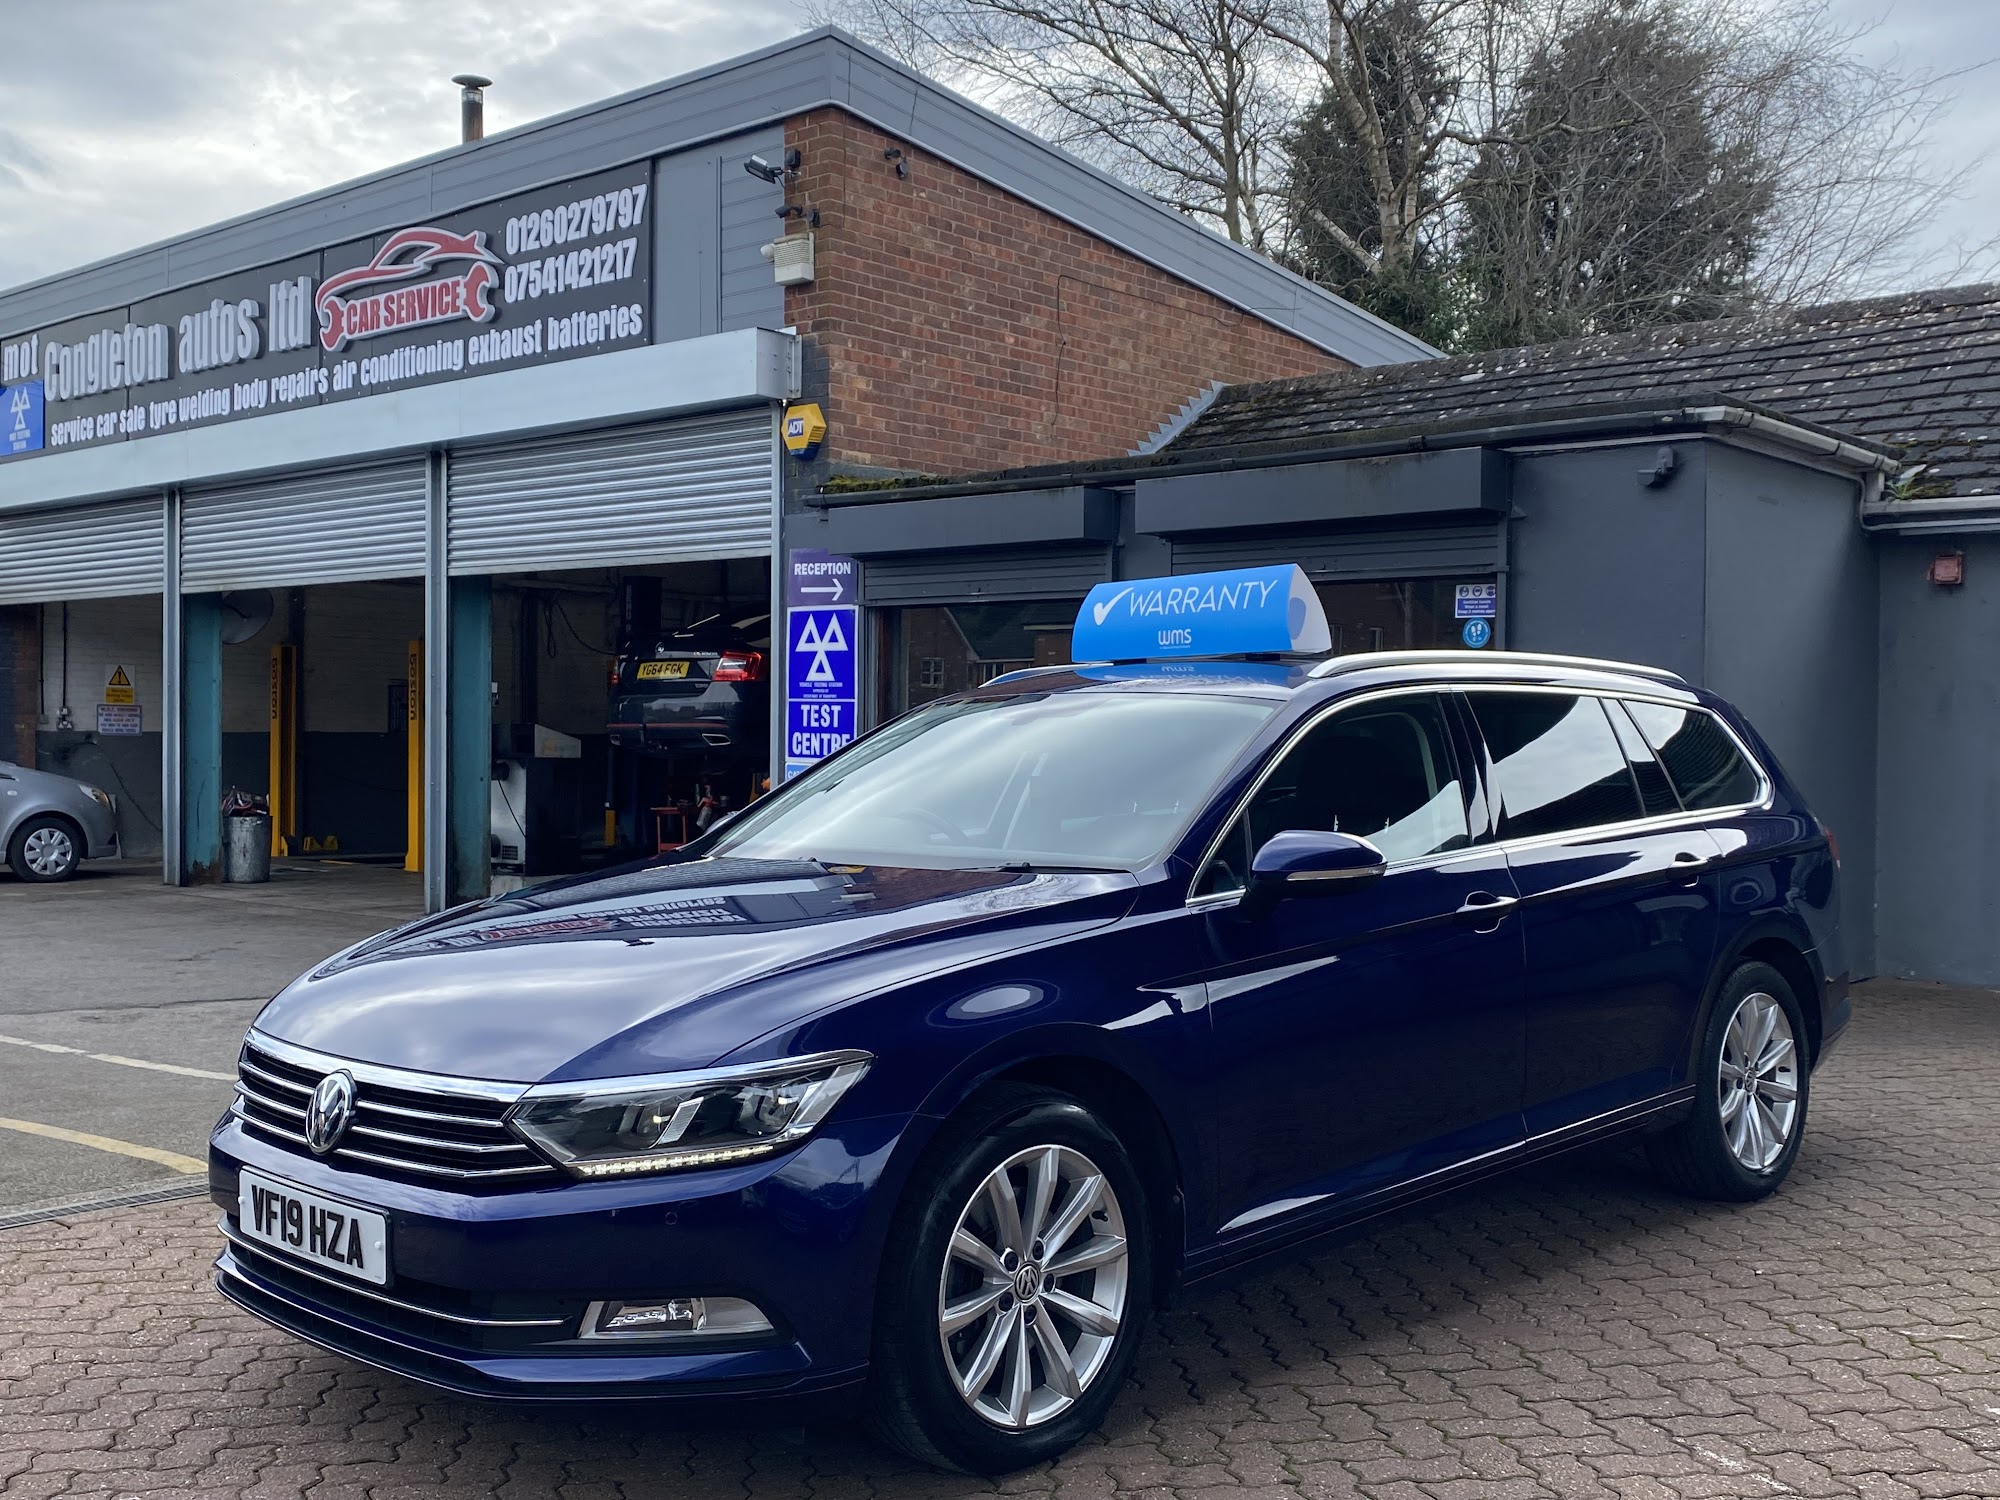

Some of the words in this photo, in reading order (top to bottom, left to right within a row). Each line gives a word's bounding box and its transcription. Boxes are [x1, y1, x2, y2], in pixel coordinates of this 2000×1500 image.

[505, 183, 648, 255] 01260279797
[504, 237, 638, 303] 07541421217
[178, 298, 260, 373] autos
[268, 275, 312, 352] ltd
[346, 298, 381, 335] CAR
[383, 279, 461, 328] SERVICE
[3, 333, 39, 381] mot
[51, 415, 95, 447] service
[96, 411, 118, 439] car
[119, 404, 146, 434] sale
[149, 398, 178, 430] tyre
[178, 387, 231, 421] welding
[233, 377, 268, 411] body
[271, 366, 329, 403] repairs
[332, 359, 358, 392] air
[360, 338, 465, 387] conditioning
[467, 318, 543, 366] exhaust
[547, 303, 643, 352] batteries
[788, 419, 805, 436] ADT
[794, 562, 851, 576] RECEPTION
[1130, 579, 1279, 617] WARRANTY
[1158, 628, 1192, 646] wms
[642, 664, 663, 676] YG64
[800, 703, 842, 728] TEST
[250, 1184, 304, 1247] VF19
[309, 1205, 365, 1270] HZA
